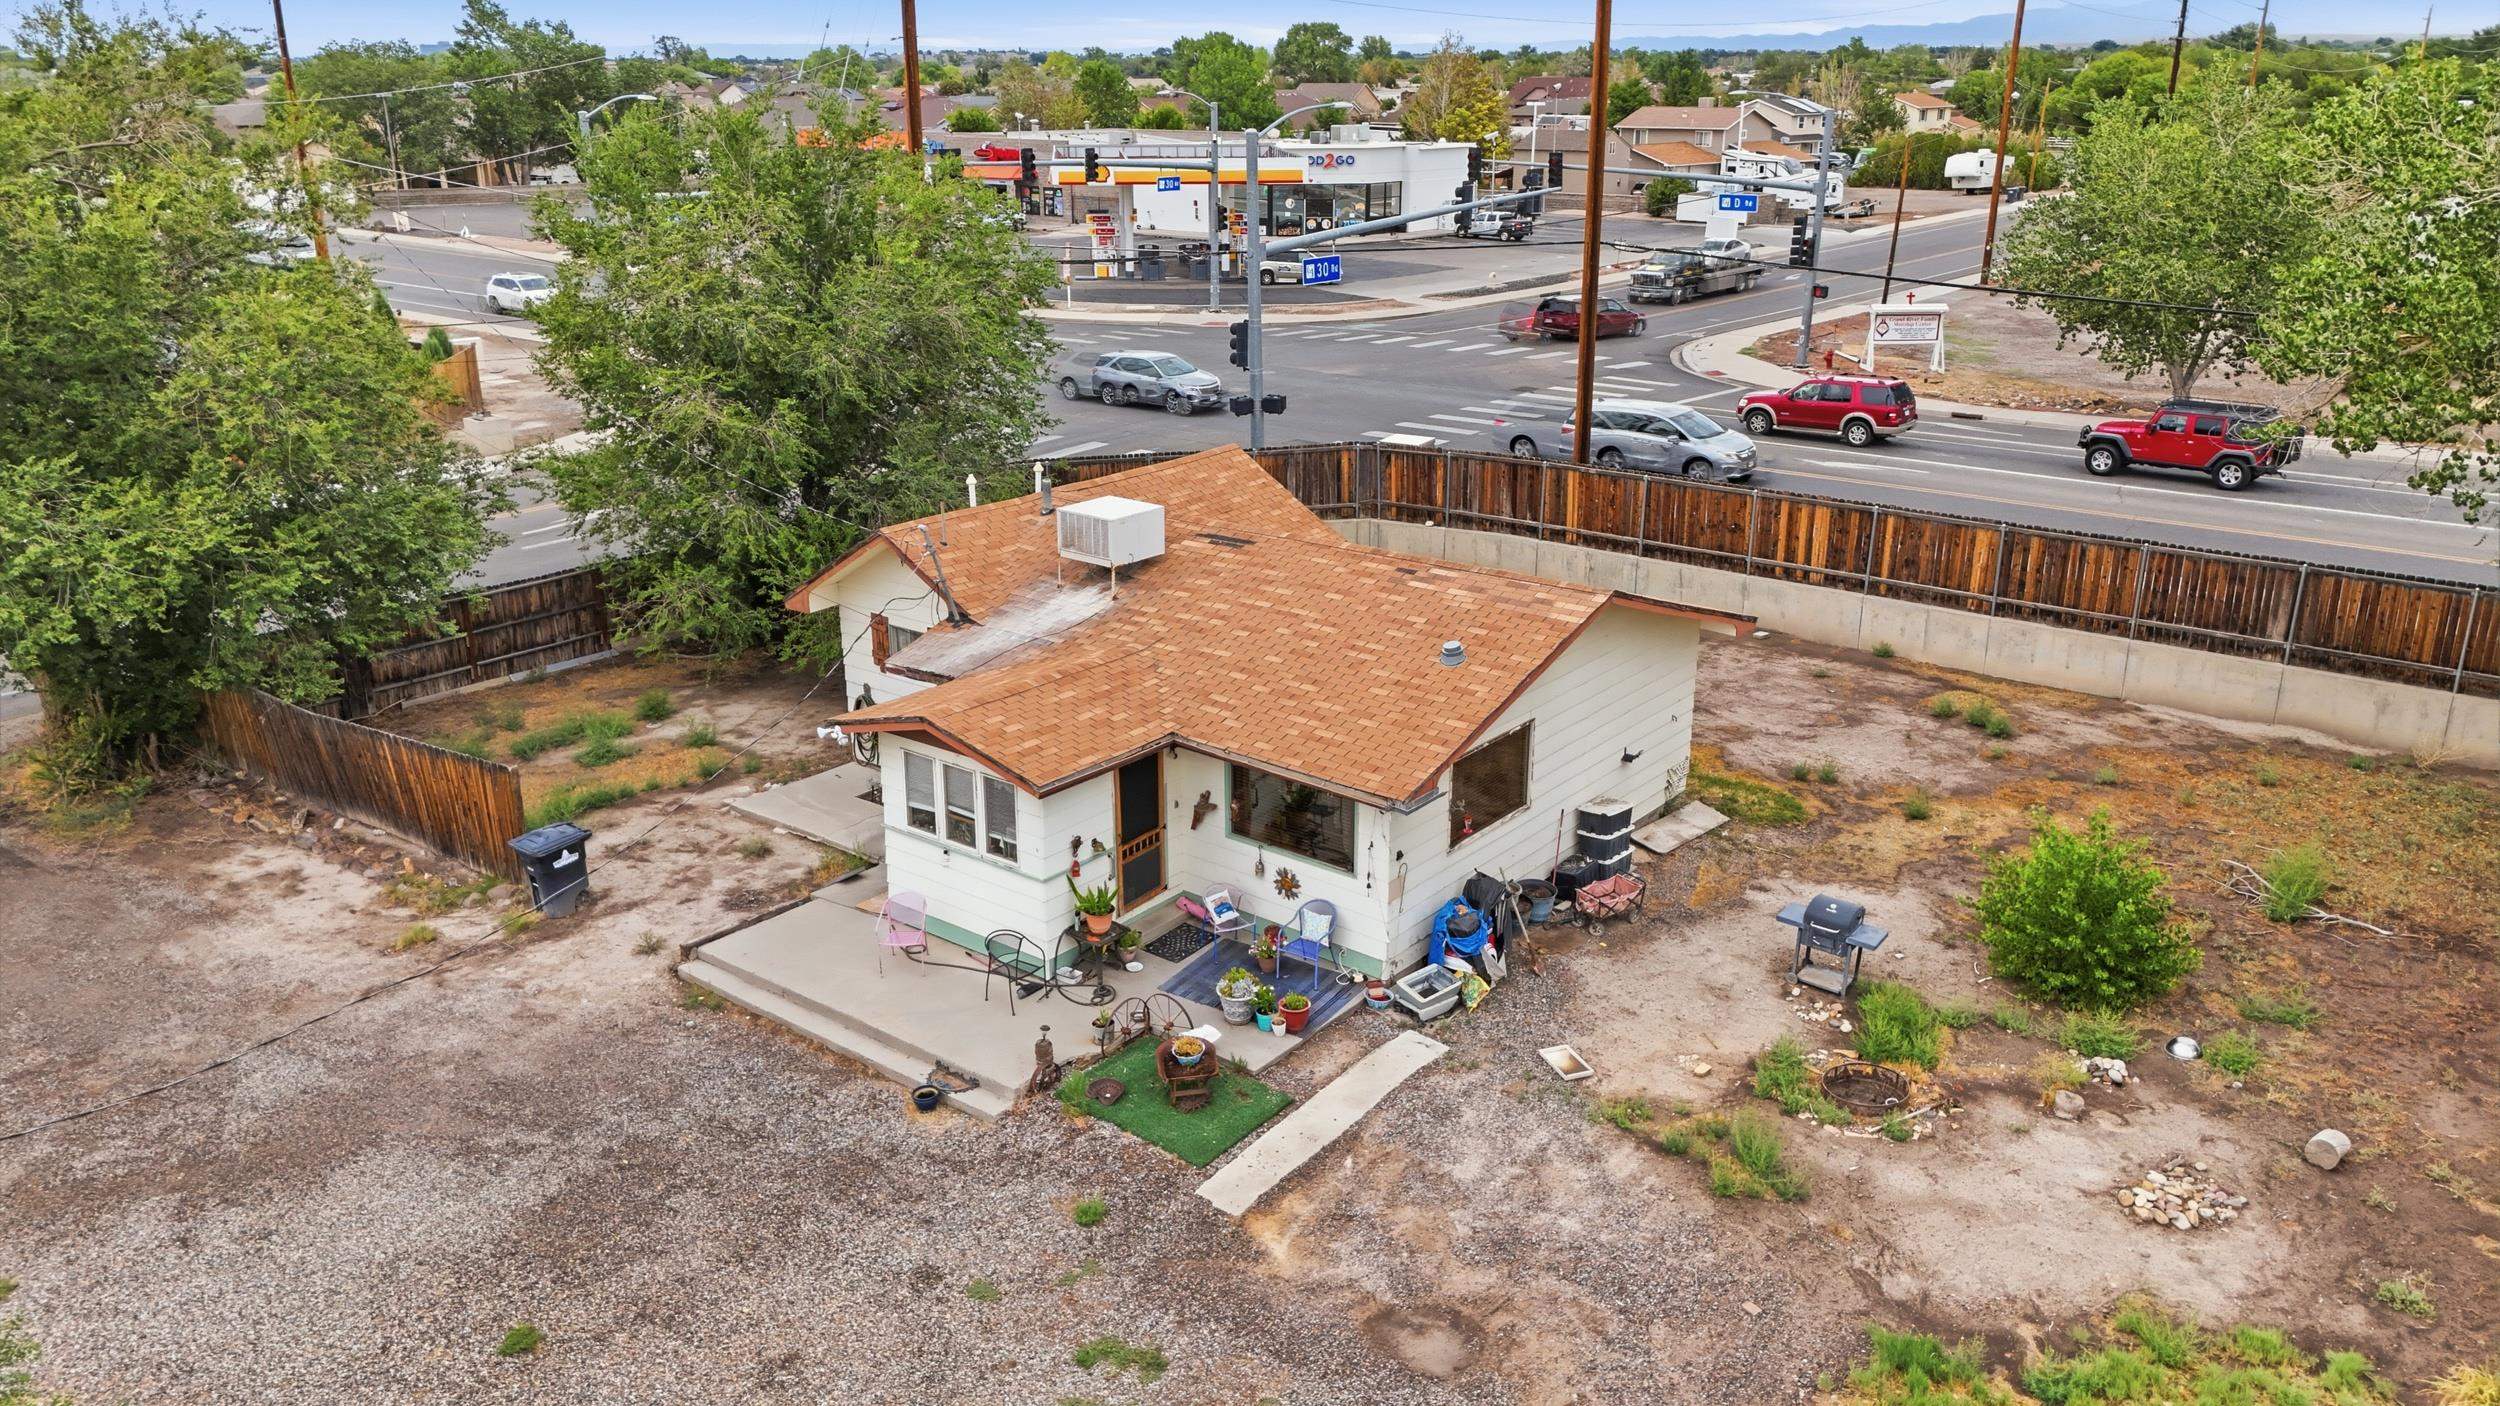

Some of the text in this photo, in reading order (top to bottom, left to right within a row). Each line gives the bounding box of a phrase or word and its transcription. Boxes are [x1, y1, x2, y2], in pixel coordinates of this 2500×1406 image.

[1165, 179, 1174, 189] 30
[1734, 197, 1741, 208] D
[1316, 262, 1329, 277] 30
